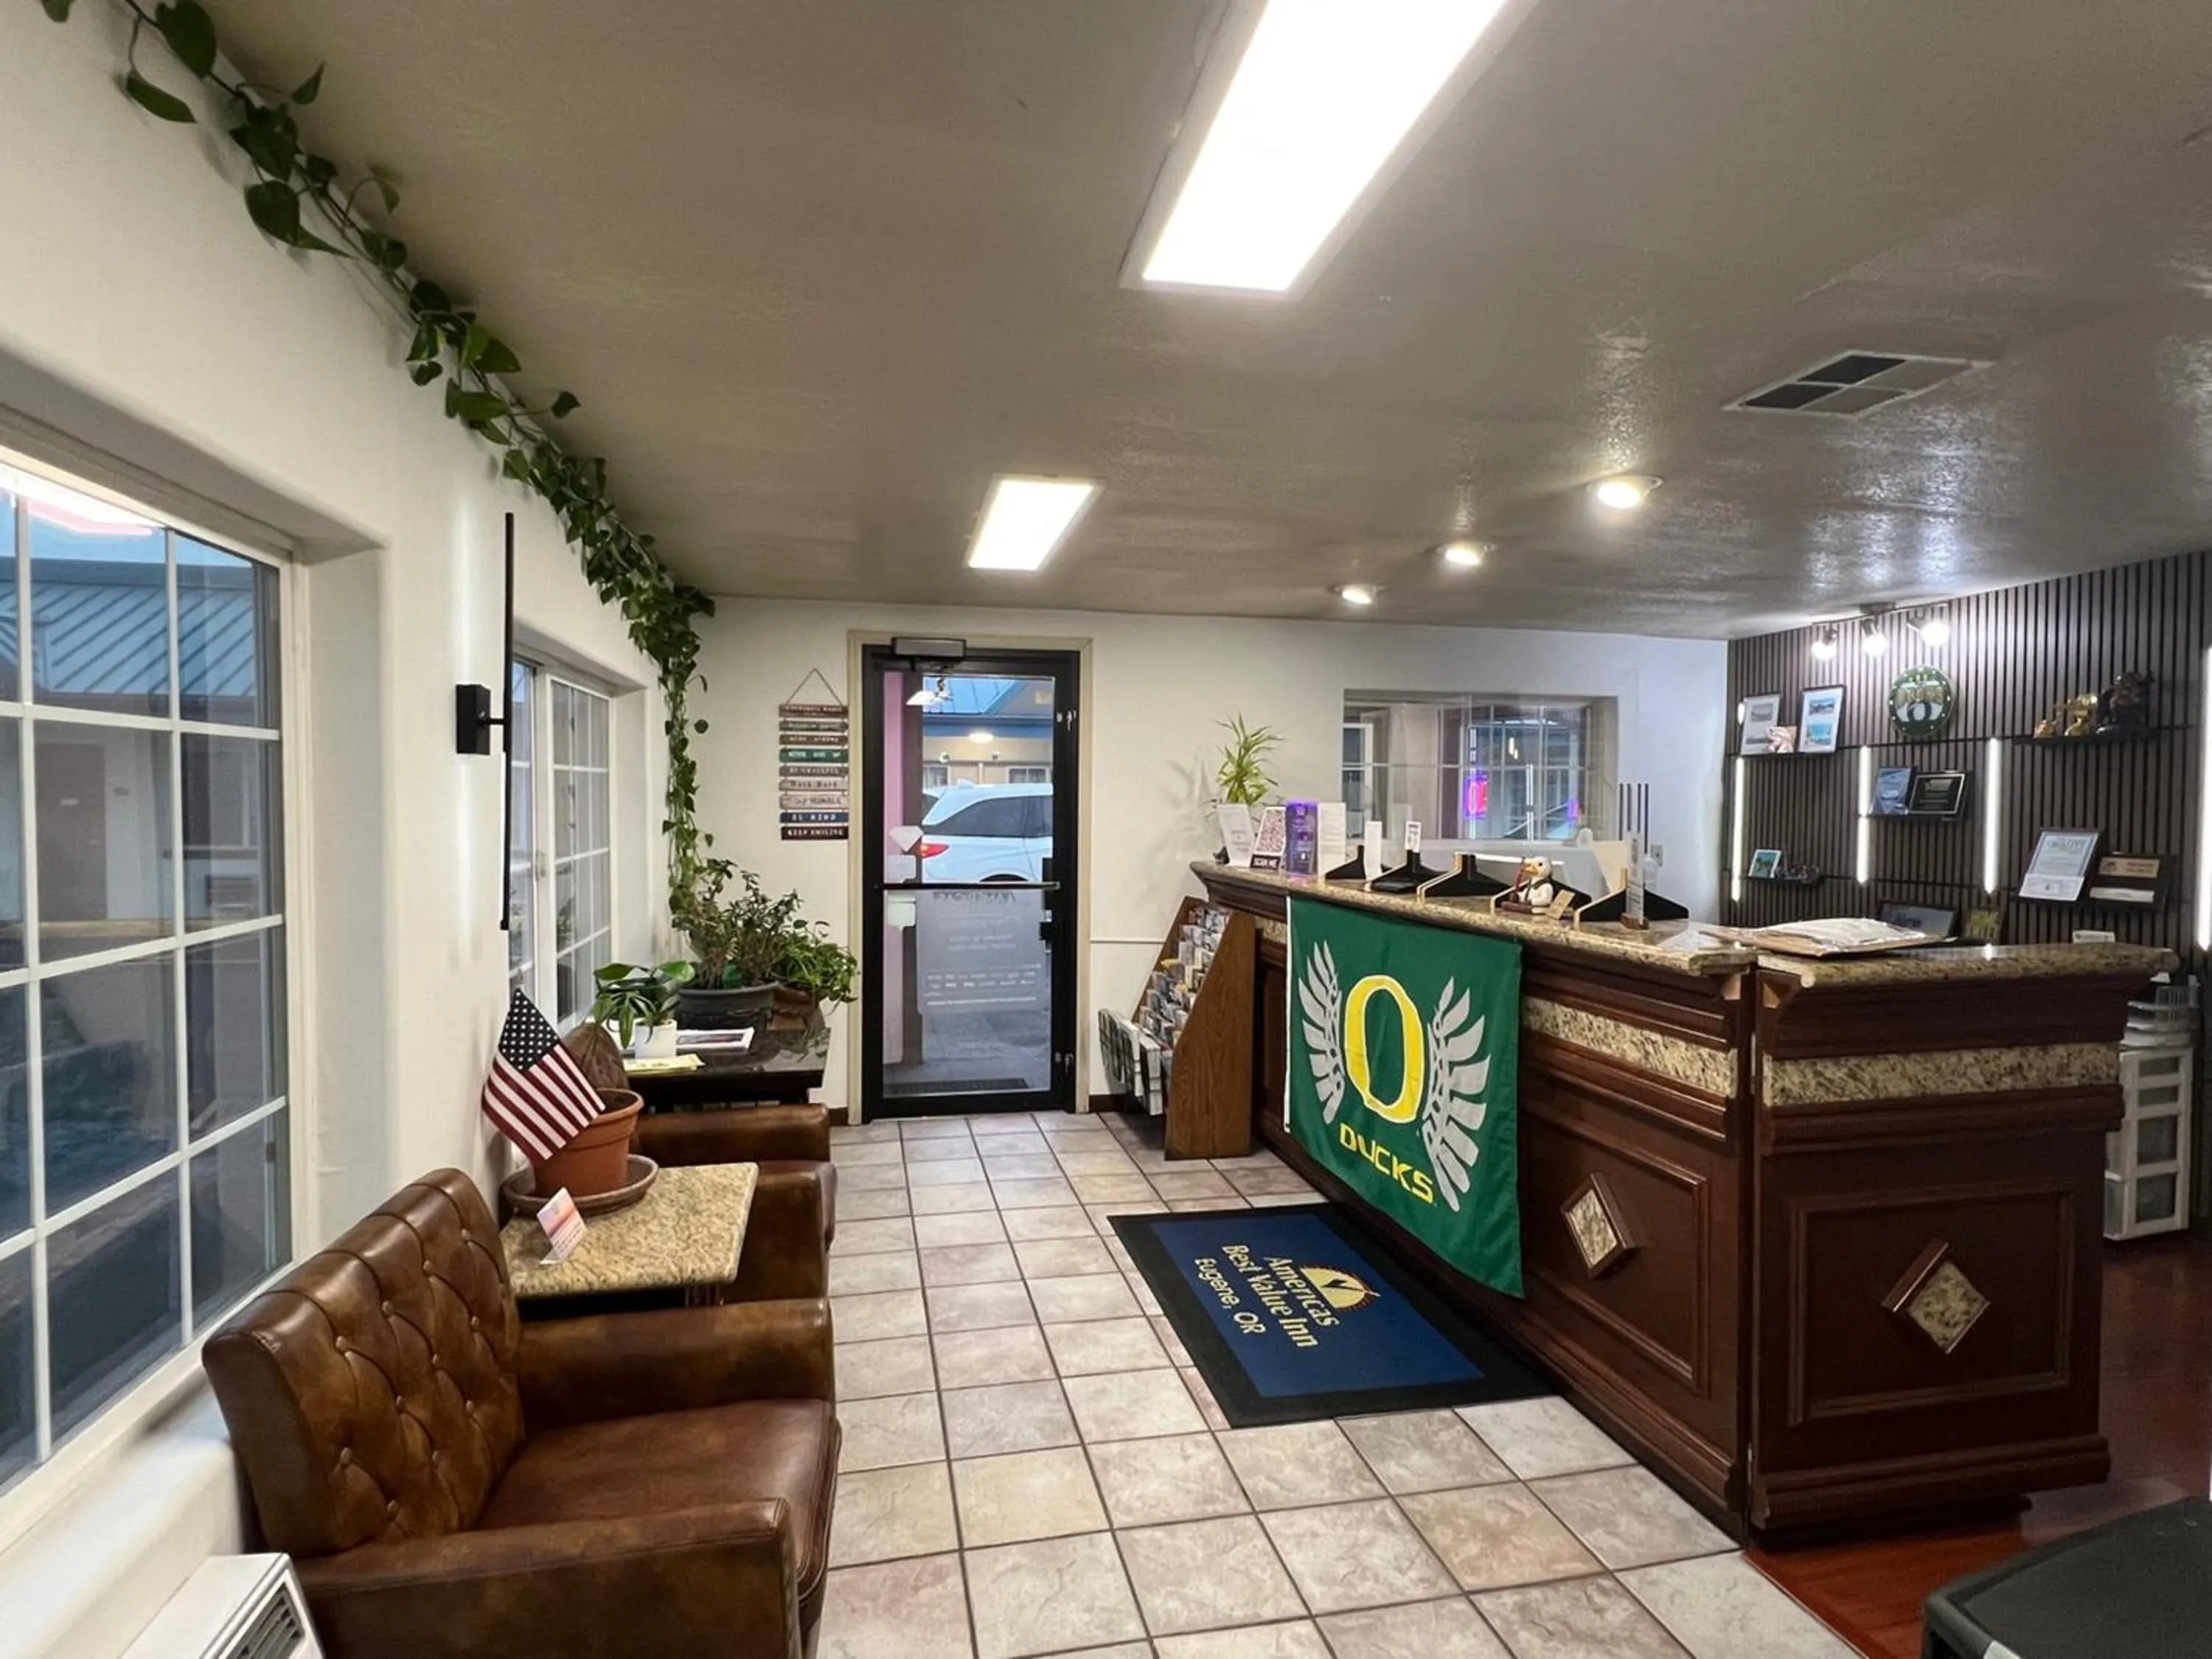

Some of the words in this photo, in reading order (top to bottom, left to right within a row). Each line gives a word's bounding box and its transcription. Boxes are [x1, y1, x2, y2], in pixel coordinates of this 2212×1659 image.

[1344, 974, 1425, 1124] O
[1339, 1121, 1435, 1204] DUCKS
[1194, 1257, 1241, 1310] Eugene,
[1233, 1311, 1266, 1335] OR
[1222, 1245, 1262, 1273] Best
[1248, 1273, 1293, 1317] Value
[1278, 1316, 1318, 1348] Inn
[1263, 1256, 1340, 1327] Americas
